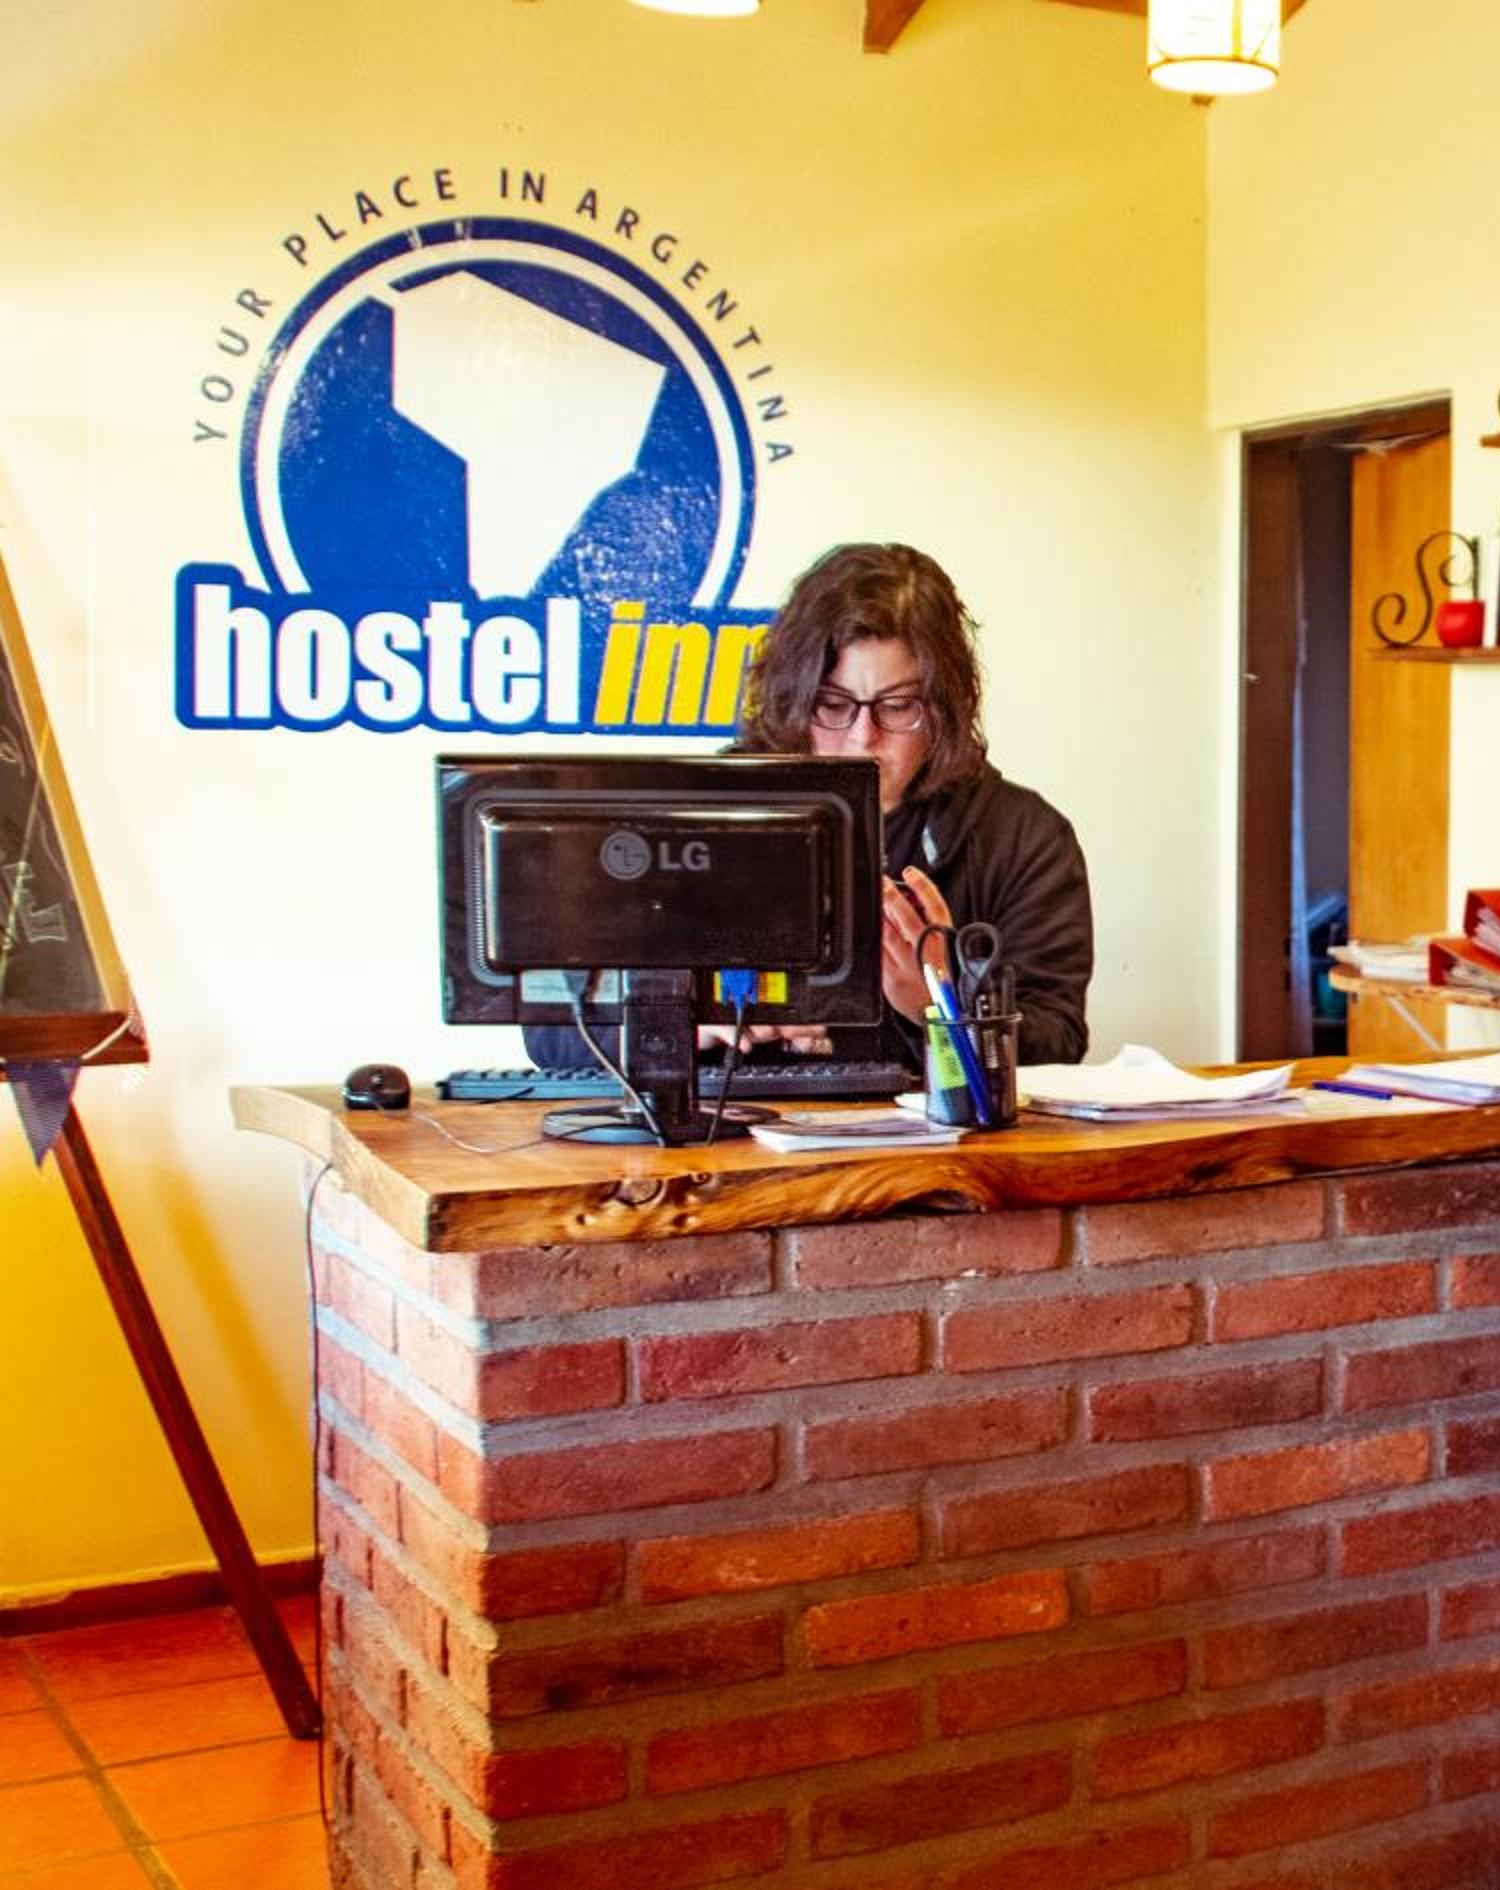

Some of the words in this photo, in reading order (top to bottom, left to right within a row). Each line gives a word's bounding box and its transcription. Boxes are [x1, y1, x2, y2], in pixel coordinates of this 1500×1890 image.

[193, 288, 272, 443] YOUR
[282, 168, 456, 267] PLACE
[500, 168, 545, 203] IN
[576, 188, 794, 463] ARGENTINA
[194, 583, 580, 725] hostel
[658, 841, 710, 871] LG
